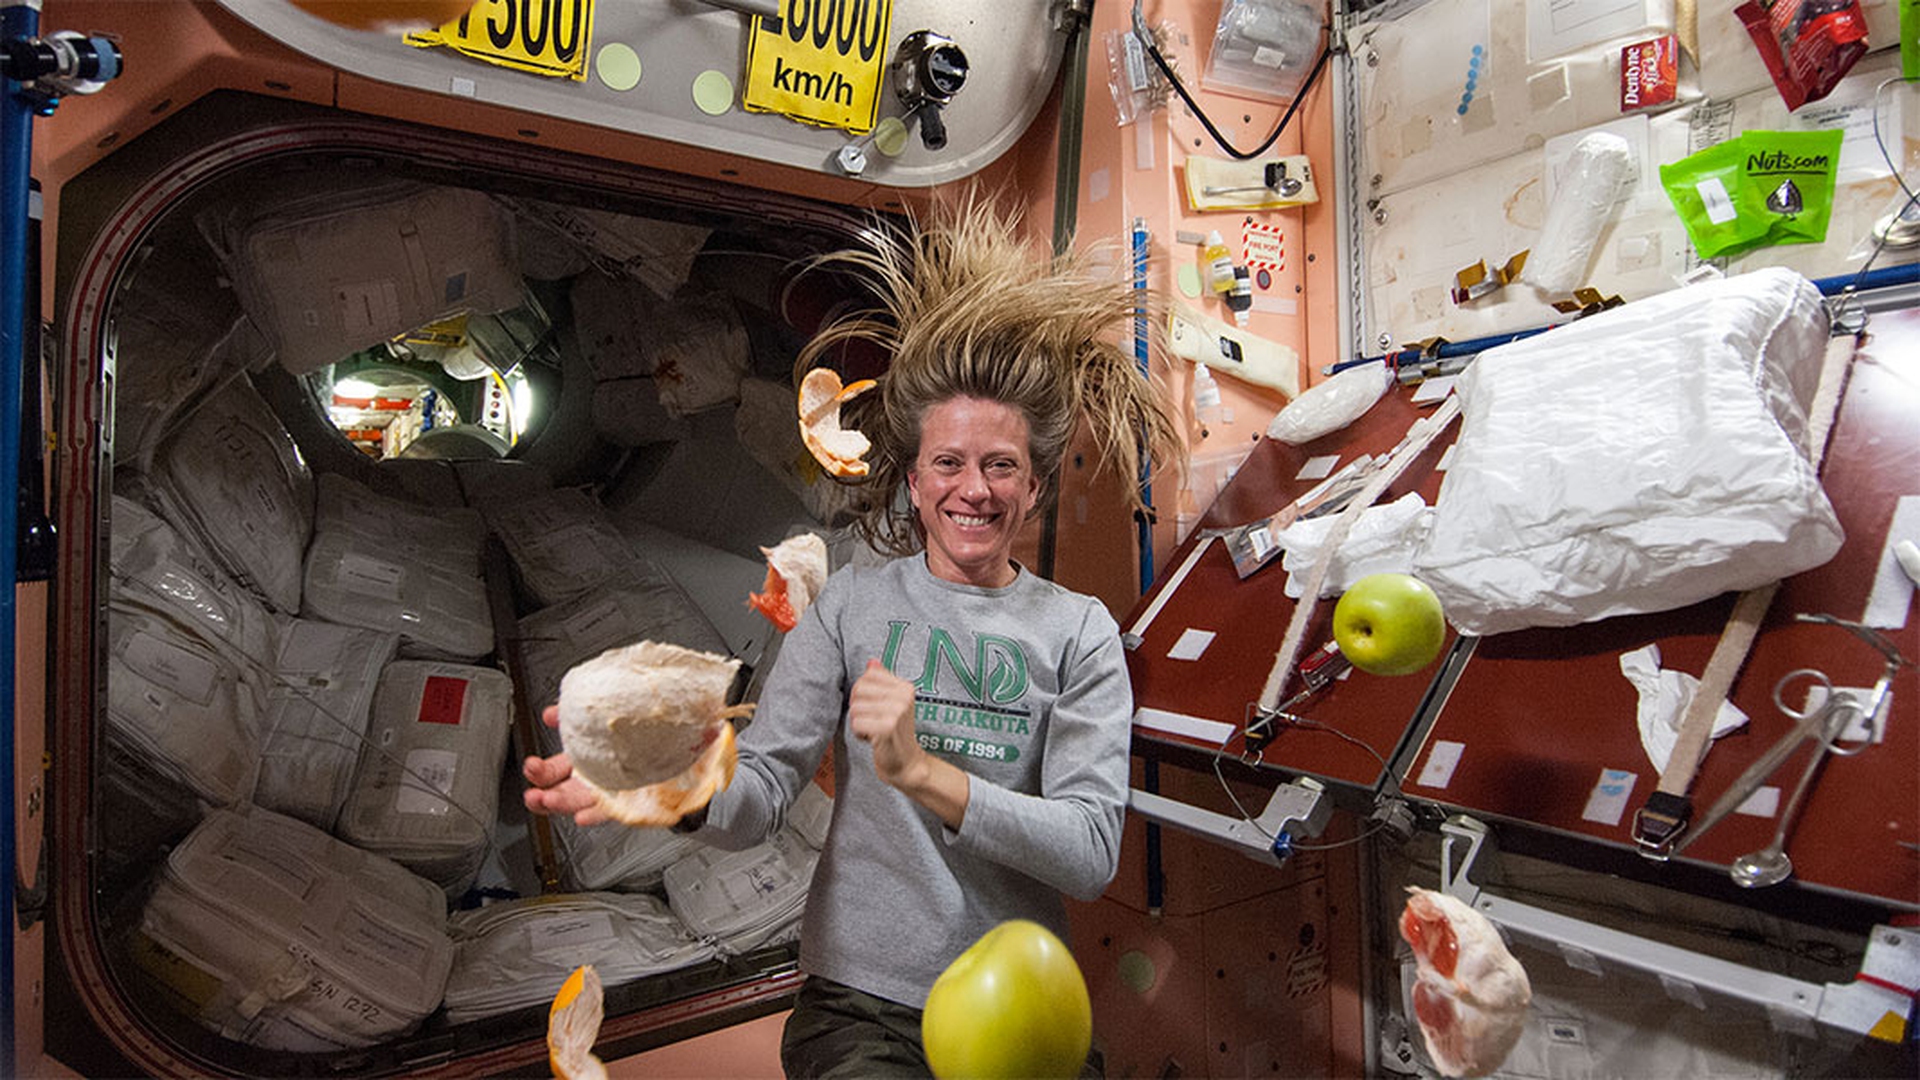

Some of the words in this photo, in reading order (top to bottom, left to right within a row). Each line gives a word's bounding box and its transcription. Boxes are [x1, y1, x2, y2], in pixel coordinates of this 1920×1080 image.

[773, 57, 853, 106] km/h
[1624, 47, 1641, 104] Dentyne
[1746, 150, 1829, 171] Nuts.com
[881, 621, 1030, 704] UND
[943, 707, 1030, 735] DAKOTA
[943, 738, 965, 752] OF
[967, 741, 1006, 760] 1994
